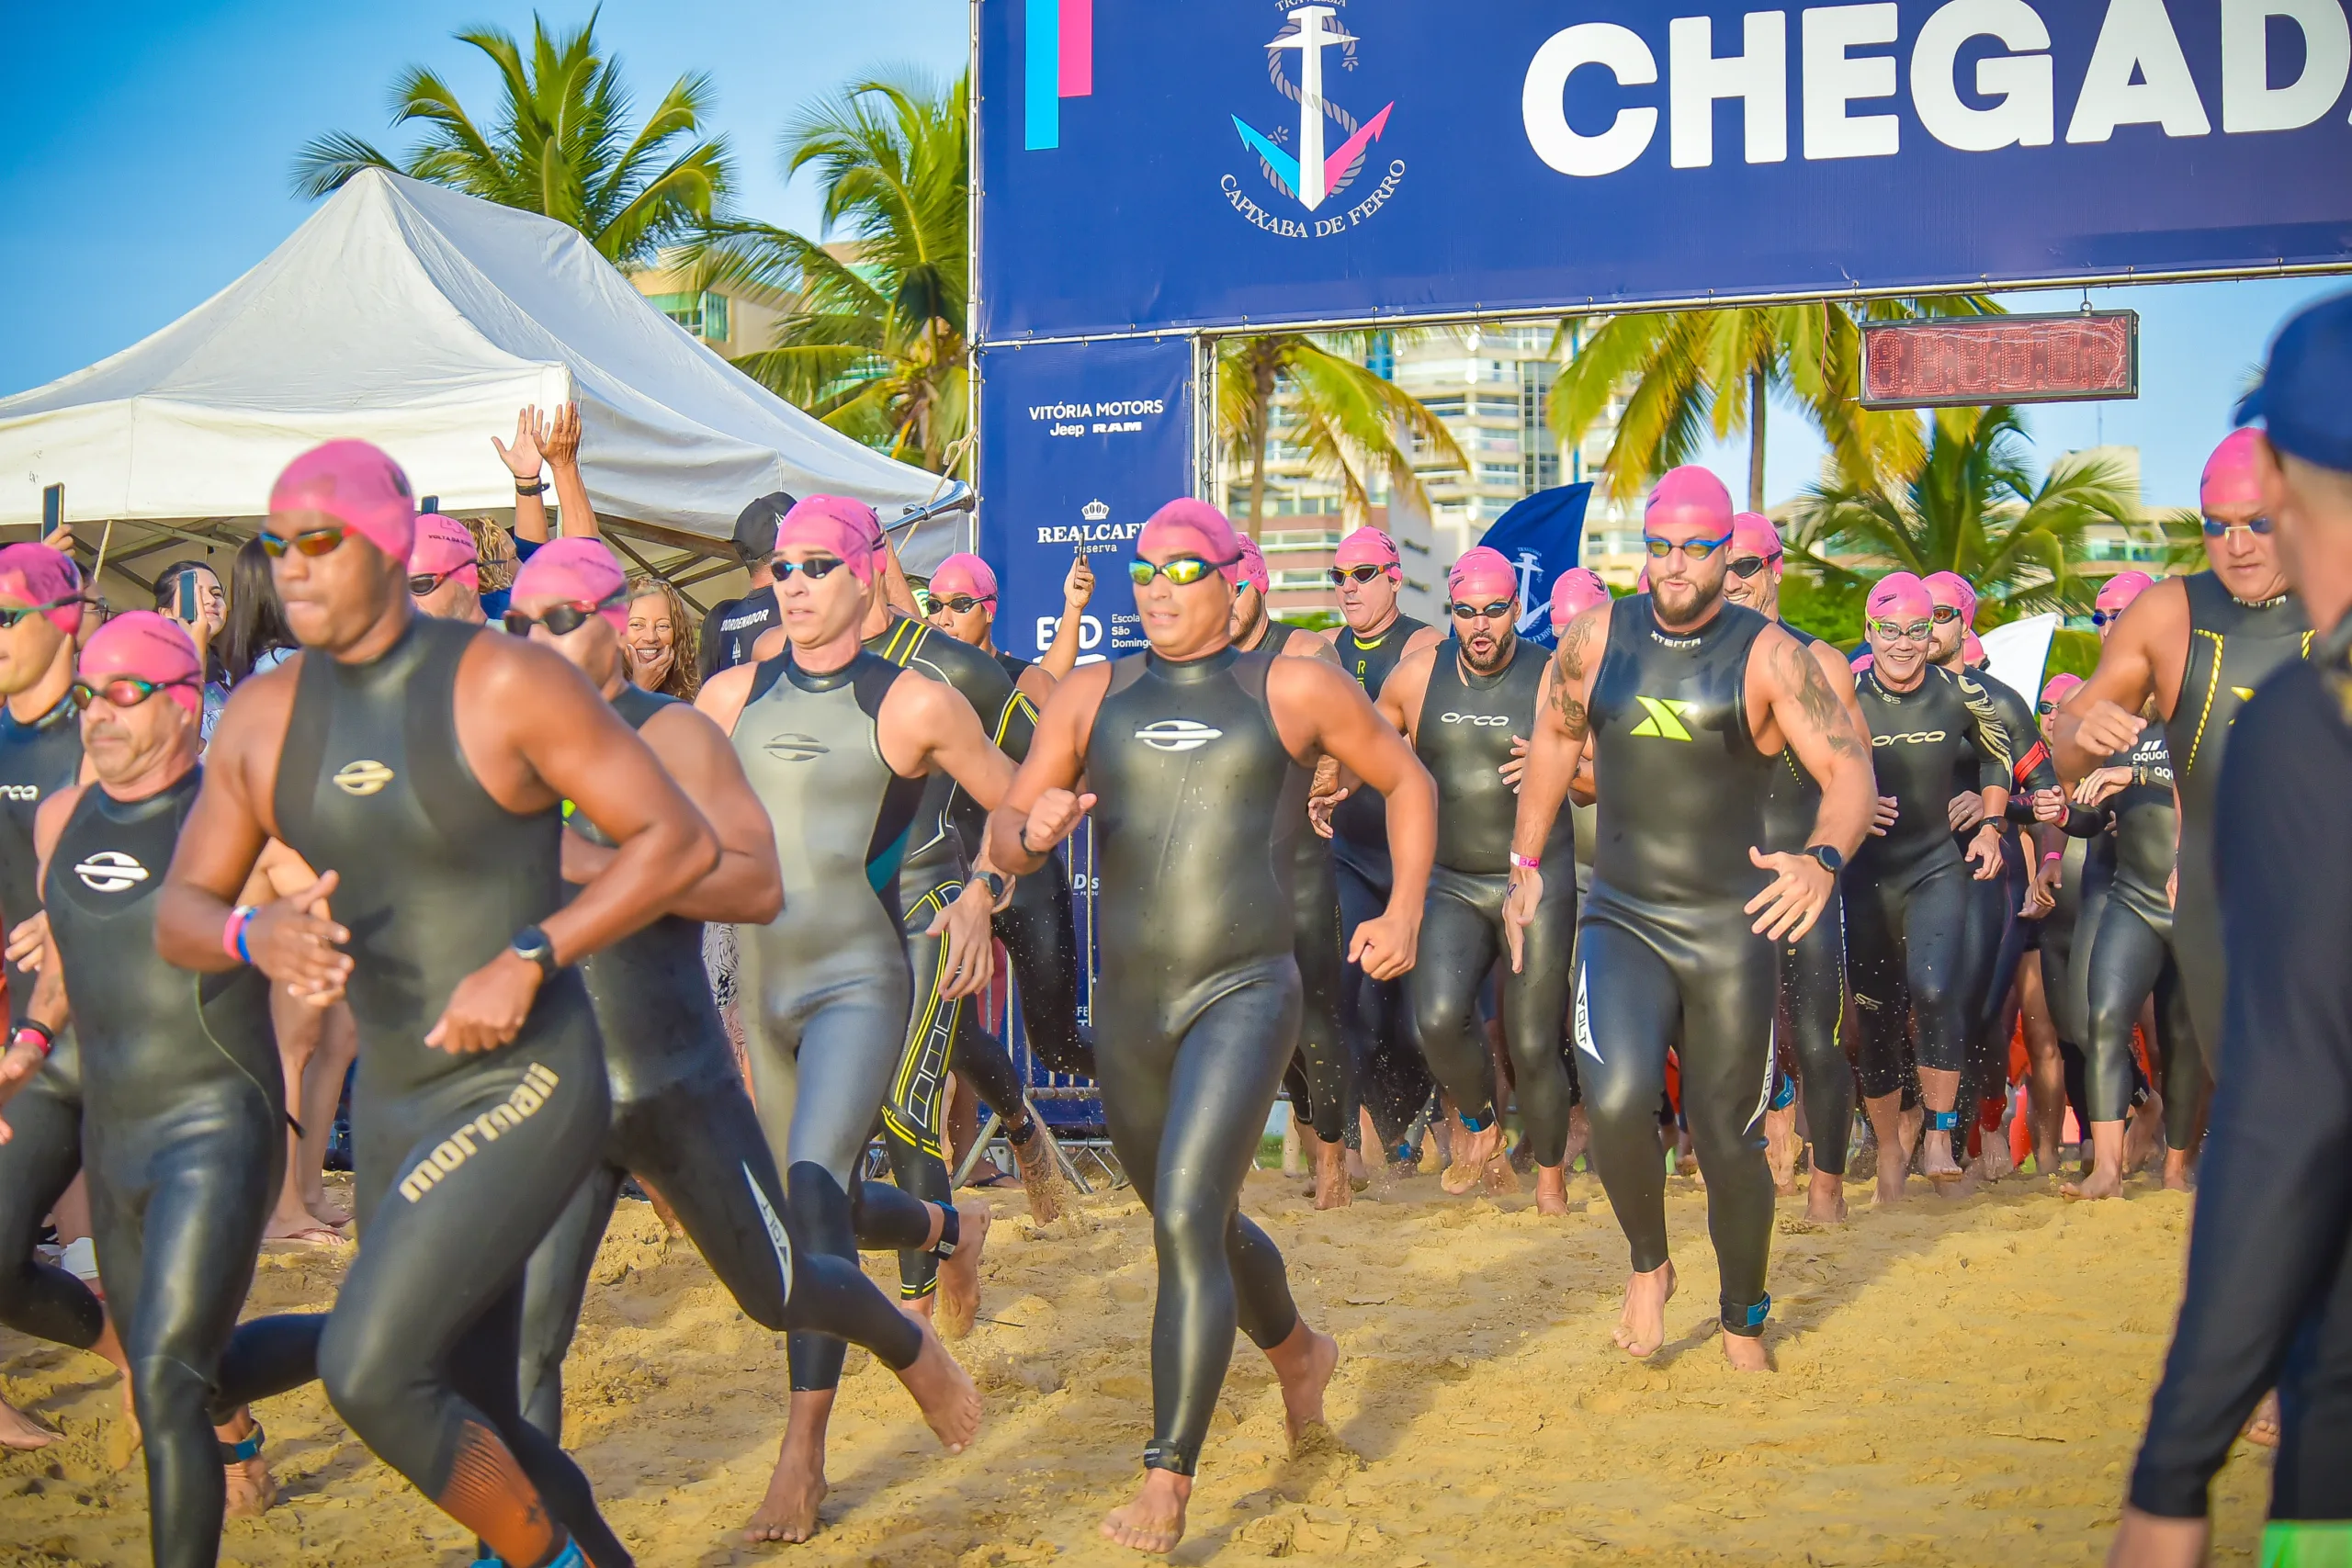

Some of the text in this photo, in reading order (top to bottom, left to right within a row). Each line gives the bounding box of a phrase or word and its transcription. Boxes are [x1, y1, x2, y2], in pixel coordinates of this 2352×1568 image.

[1521, 0, 2352, 177] CHEGAD
[1220, 159, 1406, 238] CAPIXABA DE FERRO
[1029, 399, 1164, 420] VITÓRIA MOTORS
[1049, 421, 1142, 437] Jeep RAM
[1036, 520, 1148, 543] REALCAF
[1111, 614, 1140, 624] Escola
[1111, 626, 1131, 636] São
[1441, 712, 1510, 727] orca
[1871, 730, 1946, 747] orca
[1577, 990, 1588, 1044] VOLT
[399, 1061, 560, 1203] mormaii
